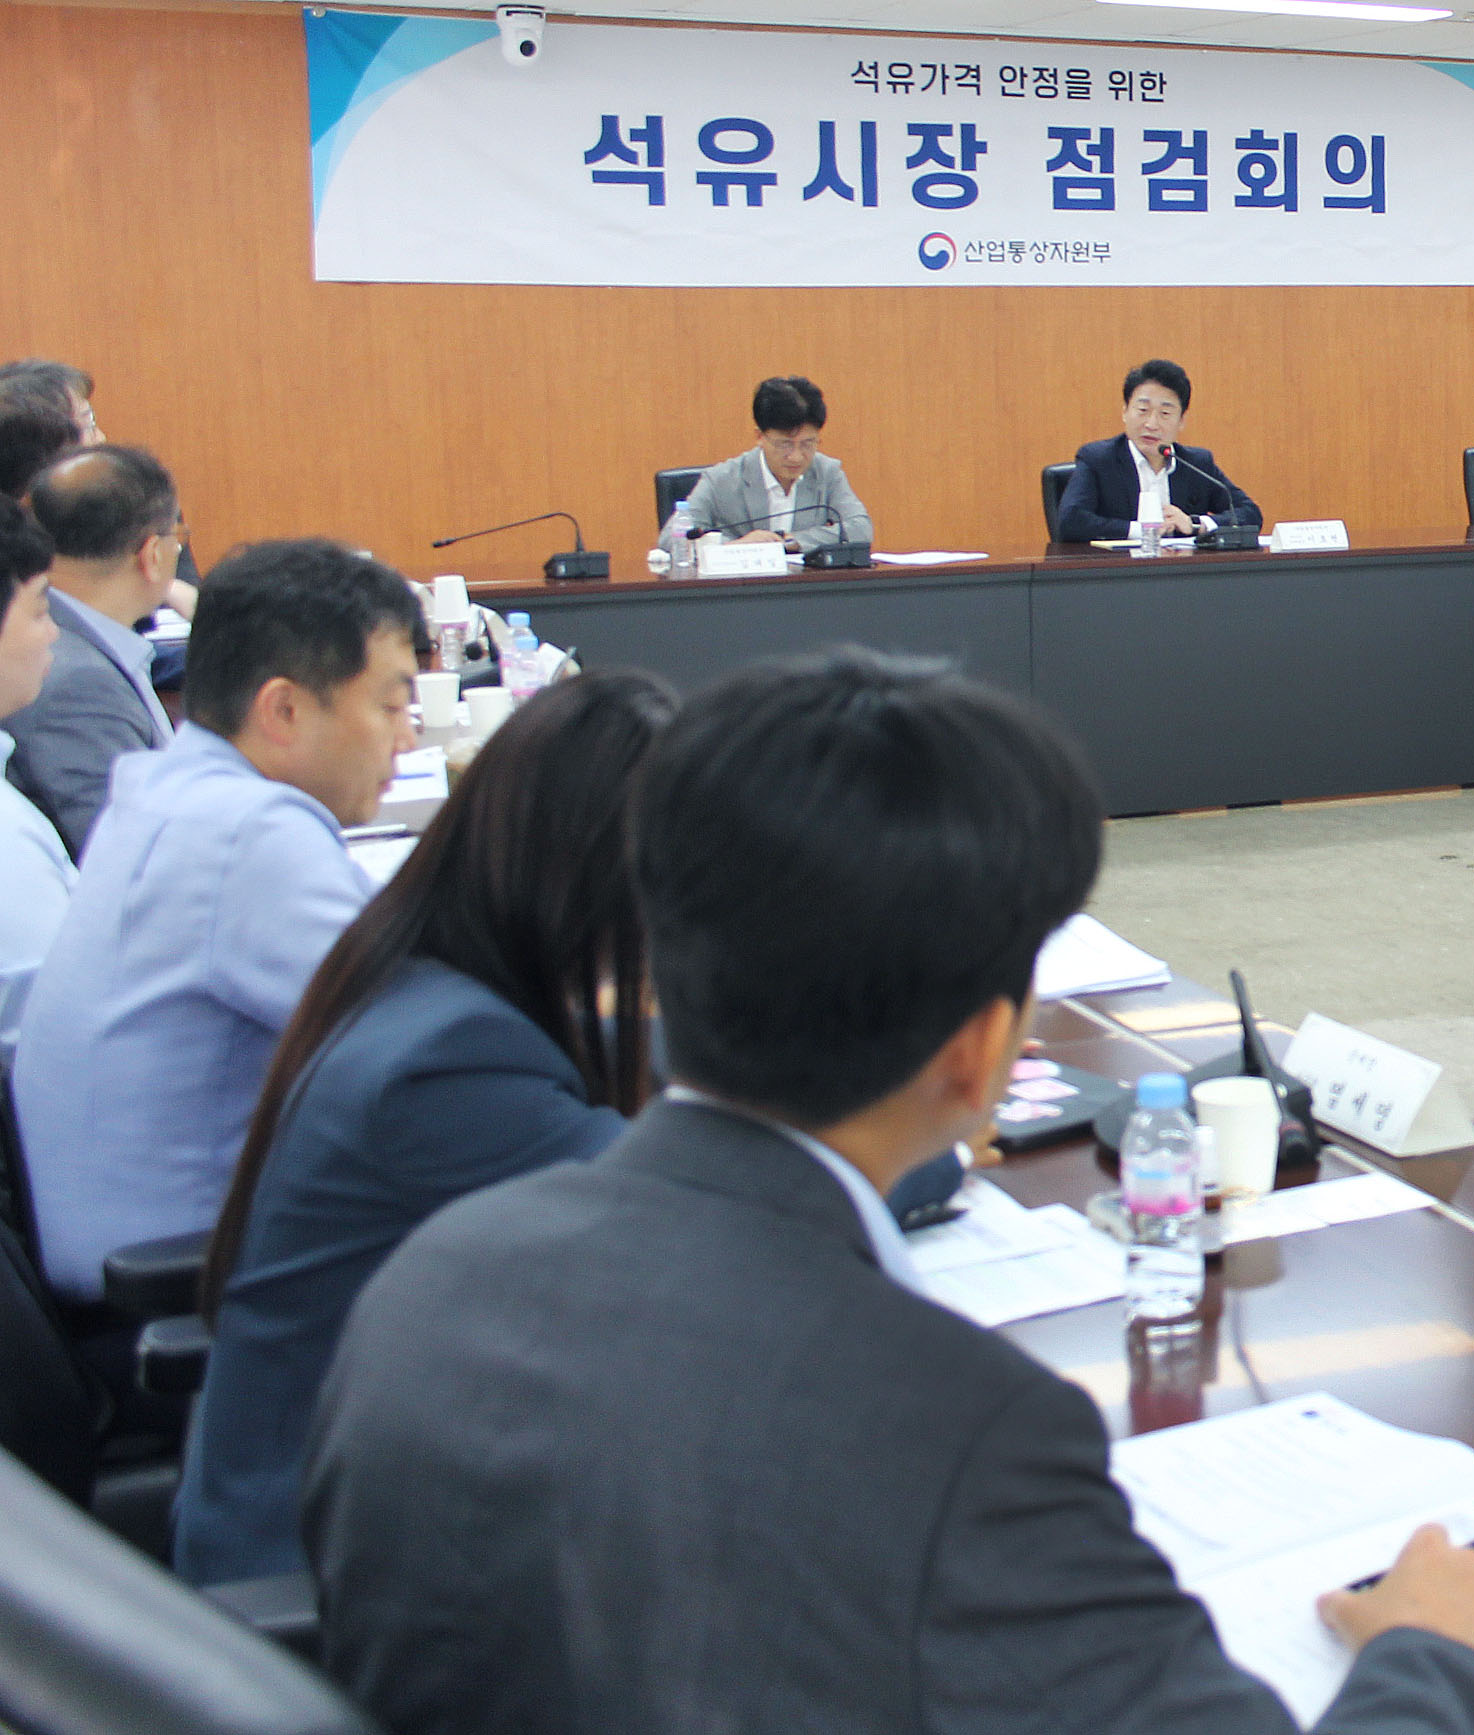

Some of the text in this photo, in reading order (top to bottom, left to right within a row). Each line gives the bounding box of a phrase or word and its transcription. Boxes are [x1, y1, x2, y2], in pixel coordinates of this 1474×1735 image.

[850, 60, 1168, 103] 석유가격 안정을 위한
[584, 114, 1386, 214] 석유시장 점검회의
[964, 240, 1112, 264] 산업통상자원부
